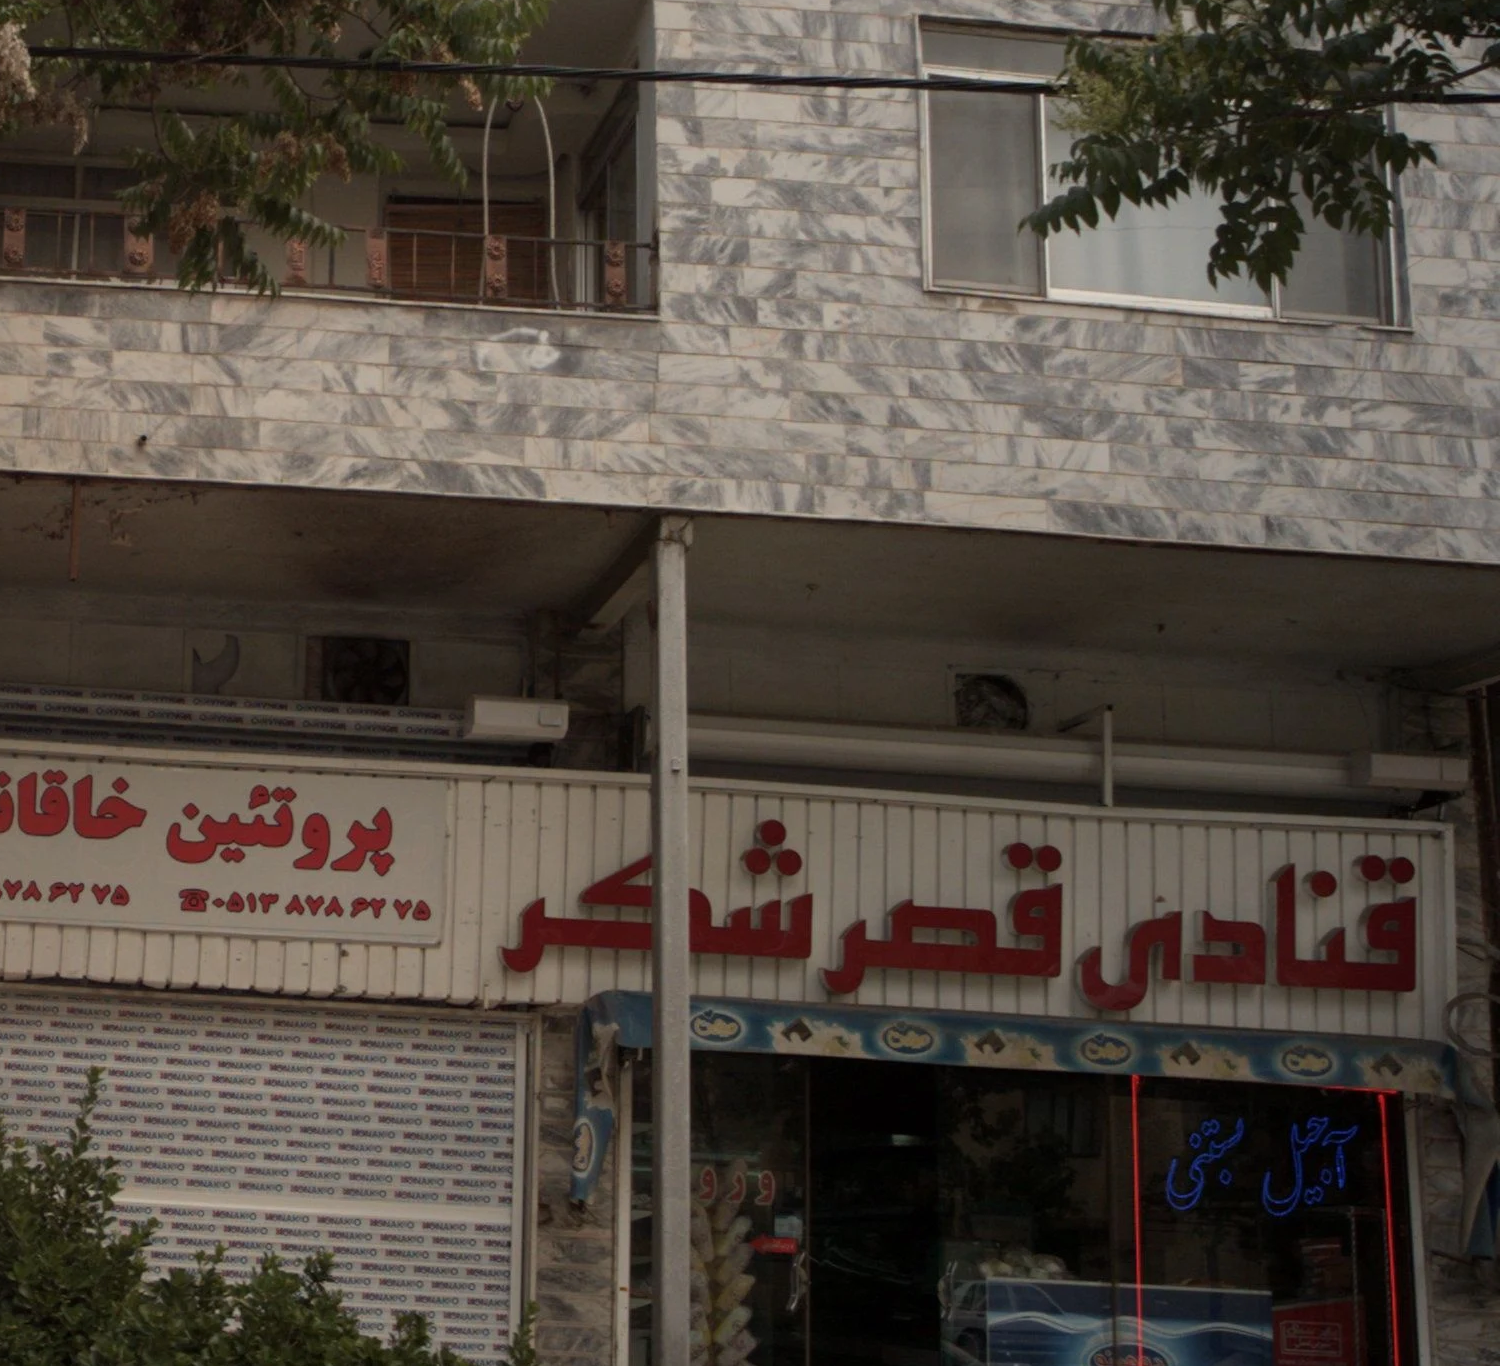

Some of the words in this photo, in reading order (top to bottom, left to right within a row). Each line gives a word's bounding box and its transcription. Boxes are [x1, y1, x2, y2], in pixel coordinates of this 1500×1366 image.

[166, 784, 394, 876] پروتئین
[48, 882, 85, 903] ۶۲
[91, 883, 130, 906] ۷۵
[212, 890, 279, 914] ۰۵۱۳
[285, 894, 344, 916] ۸۷۸
[350, 897, 386, 918] ۶۲
[393, 899, 432, 921] ۷۵
[501, 820, 813, 973] شکر
[823, 842, 1062, 994] قصر
[1081, 856, 1414, 1011] قنادی
[698, 1169, 777, 1206] ورو
[1166, 1118, 1245, 1212] بستنی
[1263, 1116, 1357, 1217] آجیل
